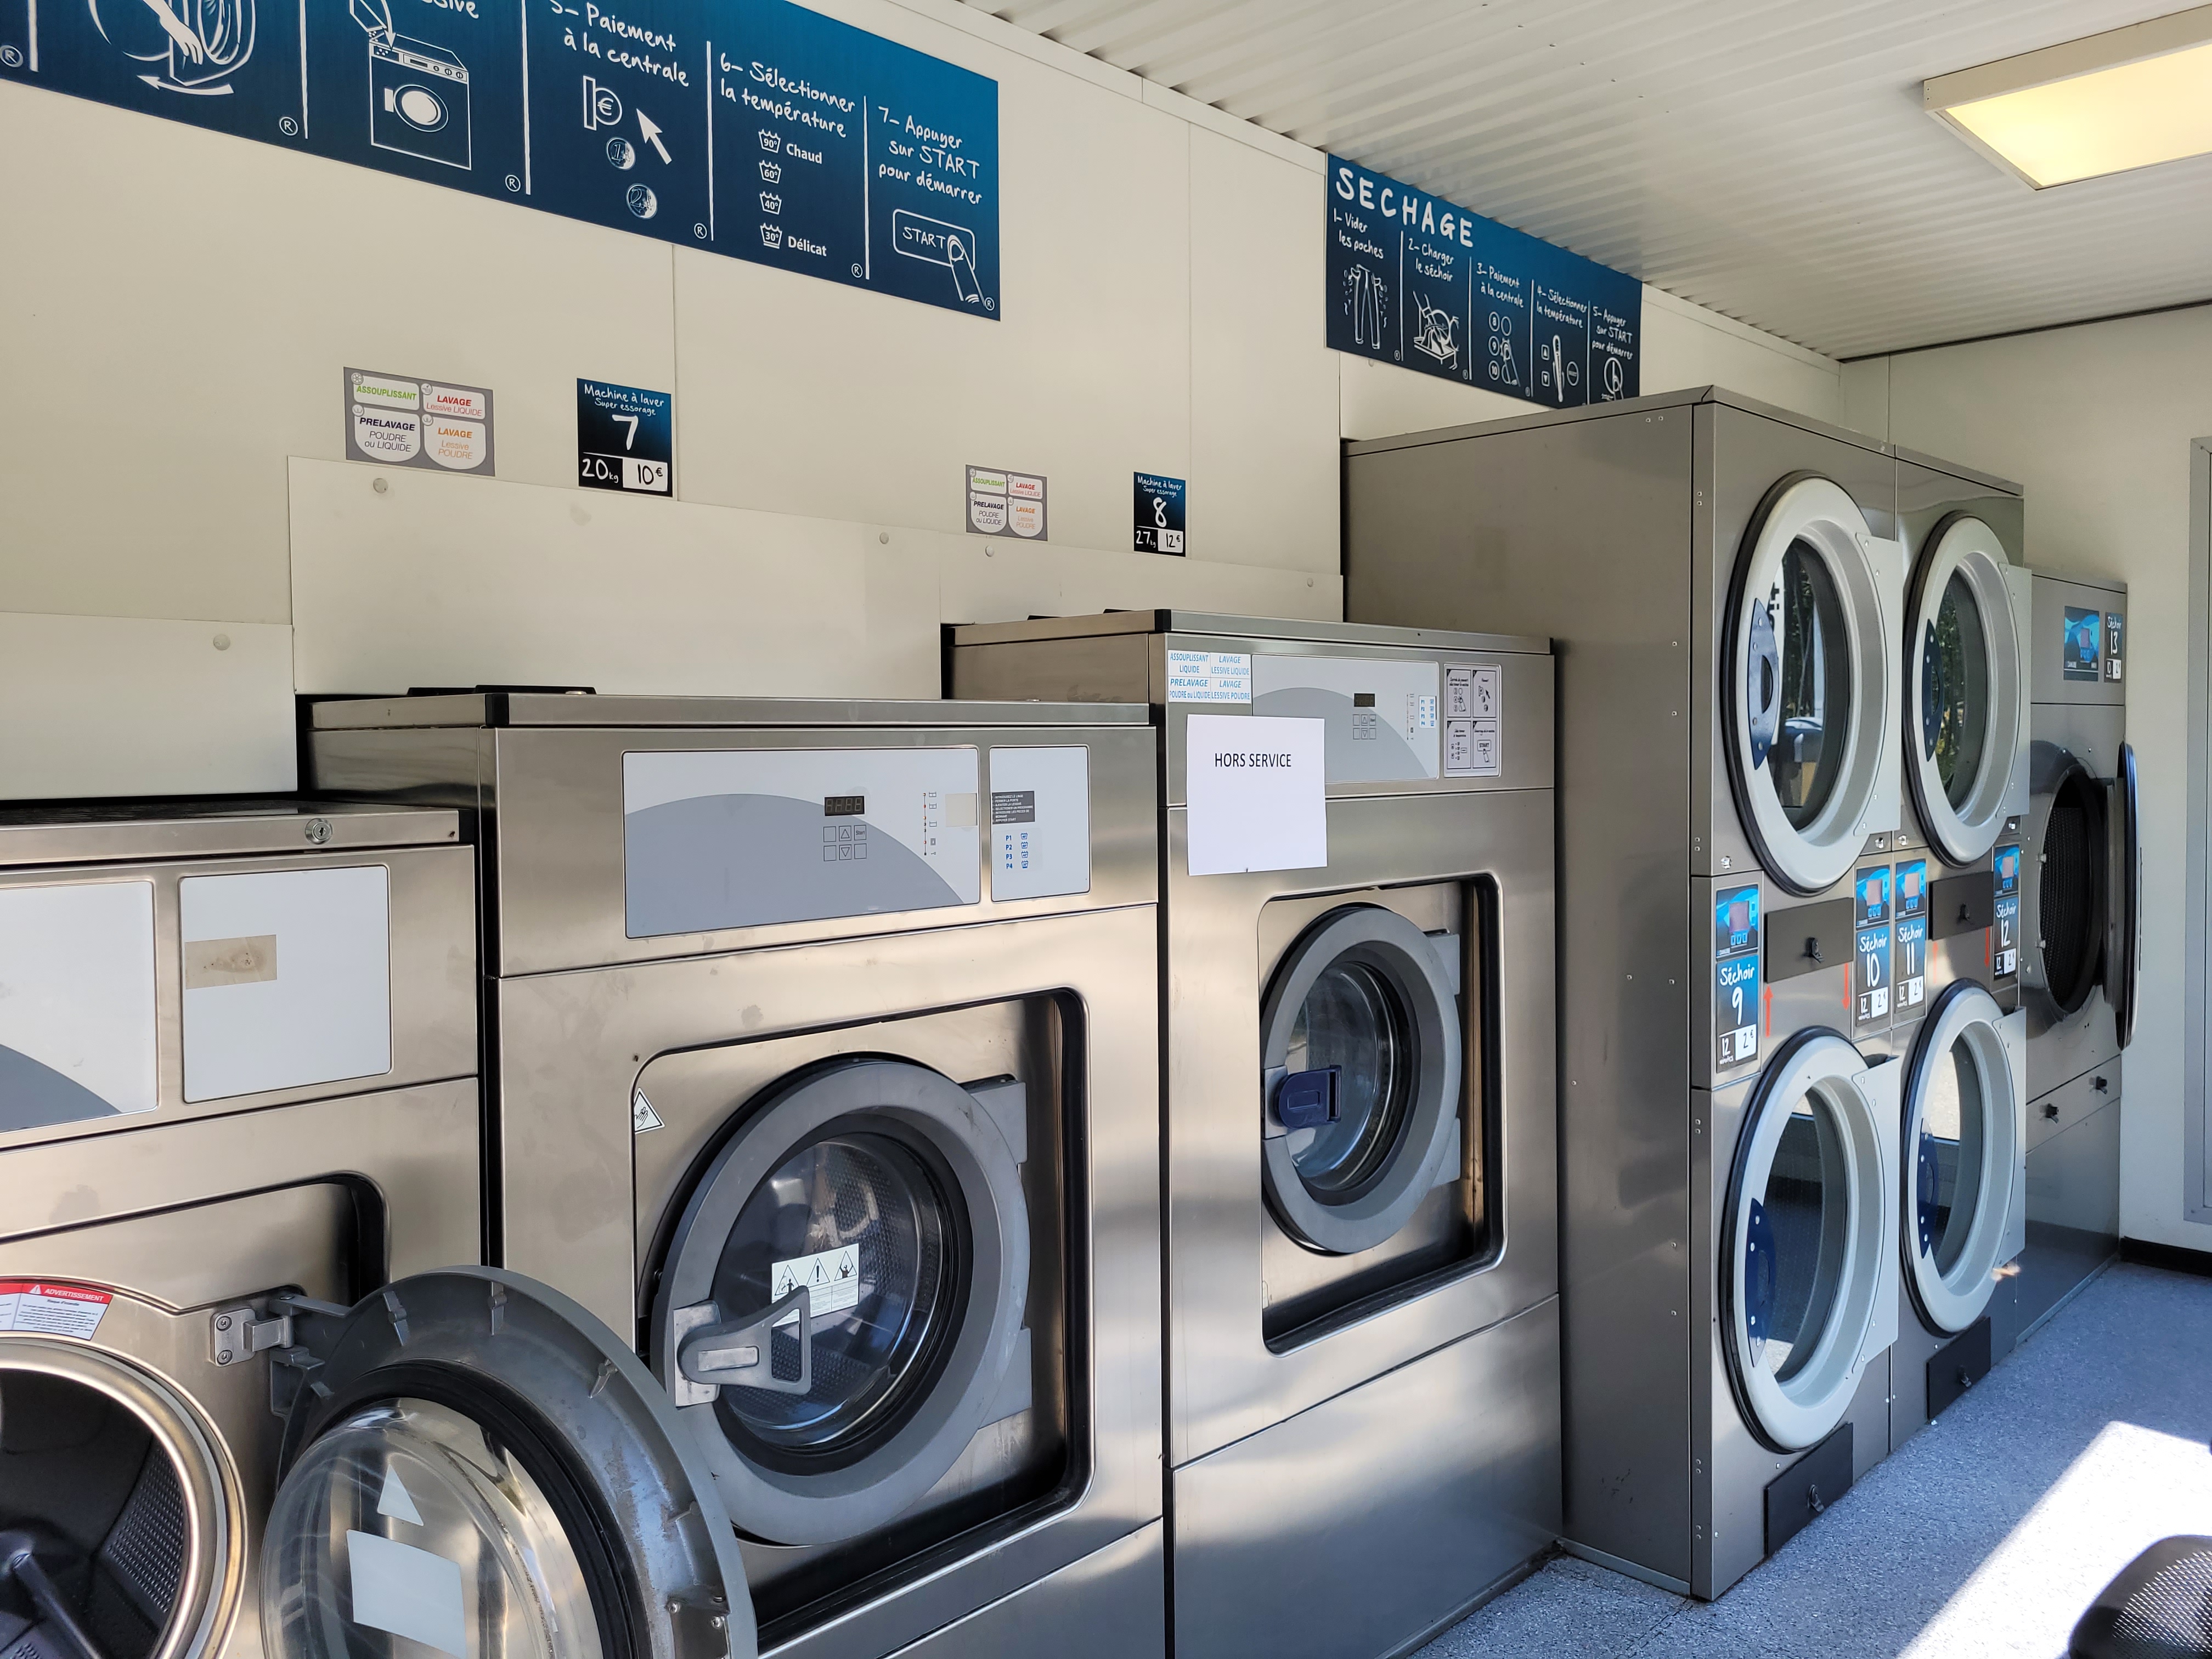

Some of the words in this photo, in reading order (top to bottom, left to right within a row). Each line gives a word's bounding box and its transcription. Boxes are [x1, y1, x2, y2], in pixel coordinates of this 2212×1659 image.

[586, 2, 676, 52] Paiement
[564, 27, 577, 50] à
[583, 32, 601, 58] la
[607, 49, 689, 87] centrale
[720, 52, 743, 72] 6-
[749, 61, 855, 112] Sélectionner
[721, 78, 736, 102] la
[742, 88, 847, 138] température
[878, 106, 900, 125] 7-
[905, 115, 962, 149] Appuyer
[763, 138, 777, 149] 90°
[786, 143, 822, 164] Chaud
[889, 140, 915, 157] sur
[919, 145, 980, 179] START
[764, 169, 778, 179] 60°
[879, 163, 911, 182] pour
[916, 171, 982, 205] démarrer
[765, 200, 778, 210] 40°
[1336, 167, 1474, 247] SECHAGE
[1345, 212, 1368, 233] Vider
[765, 231, 779, 241] 30°
[788, 236, 827, 257] Délicat
[902, 226, 946, 249] START
[1339, 229, 1352, 247] les
[1354, 240, 1384, 259] poches
[1408, 238, 1420, 250] 2-
[1421, 244, 1454, 266] Charger
[1416, 258, 1423, 273] le
[1424, 264, 1453, 283] séchoir
[1476, 262, 1487, 274] 3-
[1489, 265, 1520, 289] Paiement
[1481, 282, 1486, 295] à
[1488, 283, 1494, 297] la
[1496, 291, 1524, 308] centrale
[1548, 289, 1588, 313] Sélectionner
[1537, 300, 1543, 314] la
[1544, 305, 1583, 328] température
[1603, 308, 1627, 327] Appuyer
[1596, 325, 1607, 335] sur
[1608, 326, 1633, 344] START
[1592, 340, 1605, 349] pour
[1606, 342, 1633, 360] démarrer
[1491, 365, 1497, 375] 10
[357, 385, 417, 400] ASSOUPLISSANT
[437, 395, 472, 407] LAVAGE
[584, 383, 629, 402] Machine
[631, 392, 637, 404] à
[641, 393, 664, 407] laver
[426, 403, 452, 412] Lessive
[453, 406, 482, 416] LIQUIDE
[595, 398, 617, 409] Super
[620, 404, 656, 416] essorage
[359, 417, 416, 431] PRELAVAGE
[438, 427, 473, 438] LAVAGE
[612, 414, 639, 450] 7
[369, 431, 407, 443] POUDRE
[377, 441, 412, 452] LIQUIDE
[441, 440, 469, 450] Lessive
[438, 449, 473, 460] POUDRE
[972, 478, 1005, 487] ASSOUPLISSANT
[1137, 475, 1162, 488] Machine
[1168, 480, 1182, 490] laver
[1156, 489, 1177, 498] essorage
[974, 501, 1005, 510] PRELAVAGE
[1153, 497, 1167, 528] 8
[2111, 630, 2118, 656] 13
[1170, 653, 1209, 663] ASSOUPLISSANT
[1180, 665, 1200, 674] LIQUIDE
[1231, 667, 1250, 675] LIQUIDE
[1170, 678, 1209, 687] PRELAVAGE
[1193, 691, 1210, 699] LIQUIDE
[1211, 691, 1230, 699] LESSIVE
[1231, 692, 1250, 700] POUDRE
[1215, 753, 1246, 768] HORS
[1249, 753, 1291, 768] SERVICE
[1996, 902, 2016, 918] Séchoir
[1859, 933, 1887, 952] Séchoir
[1898, 924, 1923, 943] Séchoir
[2001, 919, 2011, 948] 12
[1906, 941, 1915, 976] 11
[1719, 963, 1755, 986] Séchoir
[1866, 953, 1880, 988] 10
[1732, 986, 1743, 1025] 9
[1722, 1037, 1730, 1057] 12
[44, 1288, 104, 1302] ADVERTISSEMENT
